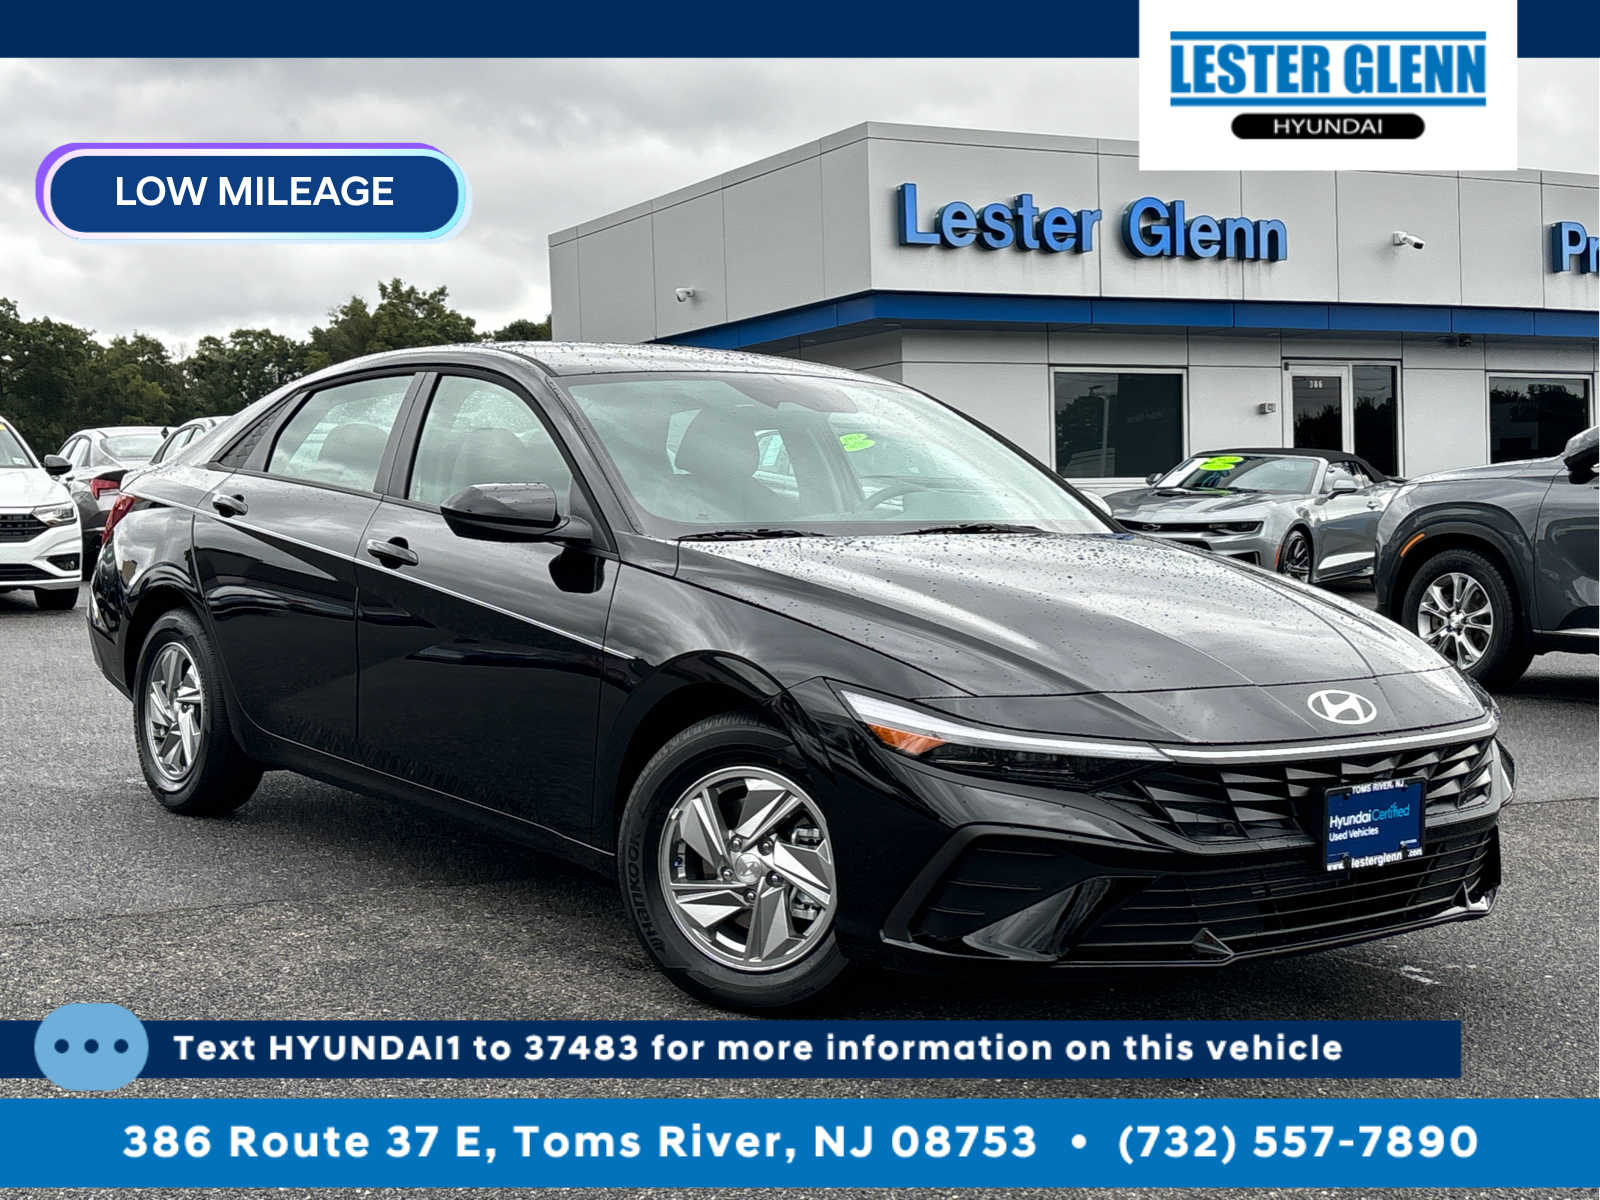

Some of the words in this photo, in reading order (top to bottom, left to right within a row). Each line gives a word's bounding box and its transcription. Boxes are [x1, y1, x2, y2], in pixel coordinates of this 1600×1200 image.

[897, 182, 1102, 253] Lester
[1122, 195, 1288, 262] Glenn
[1395, 778, 1405, 788] NJ
[1328, 829, 1348, 842] Used
[1348, 826, 1379, 839] Vehicles
[1351, 851, 1403, 869] lesterglenn
